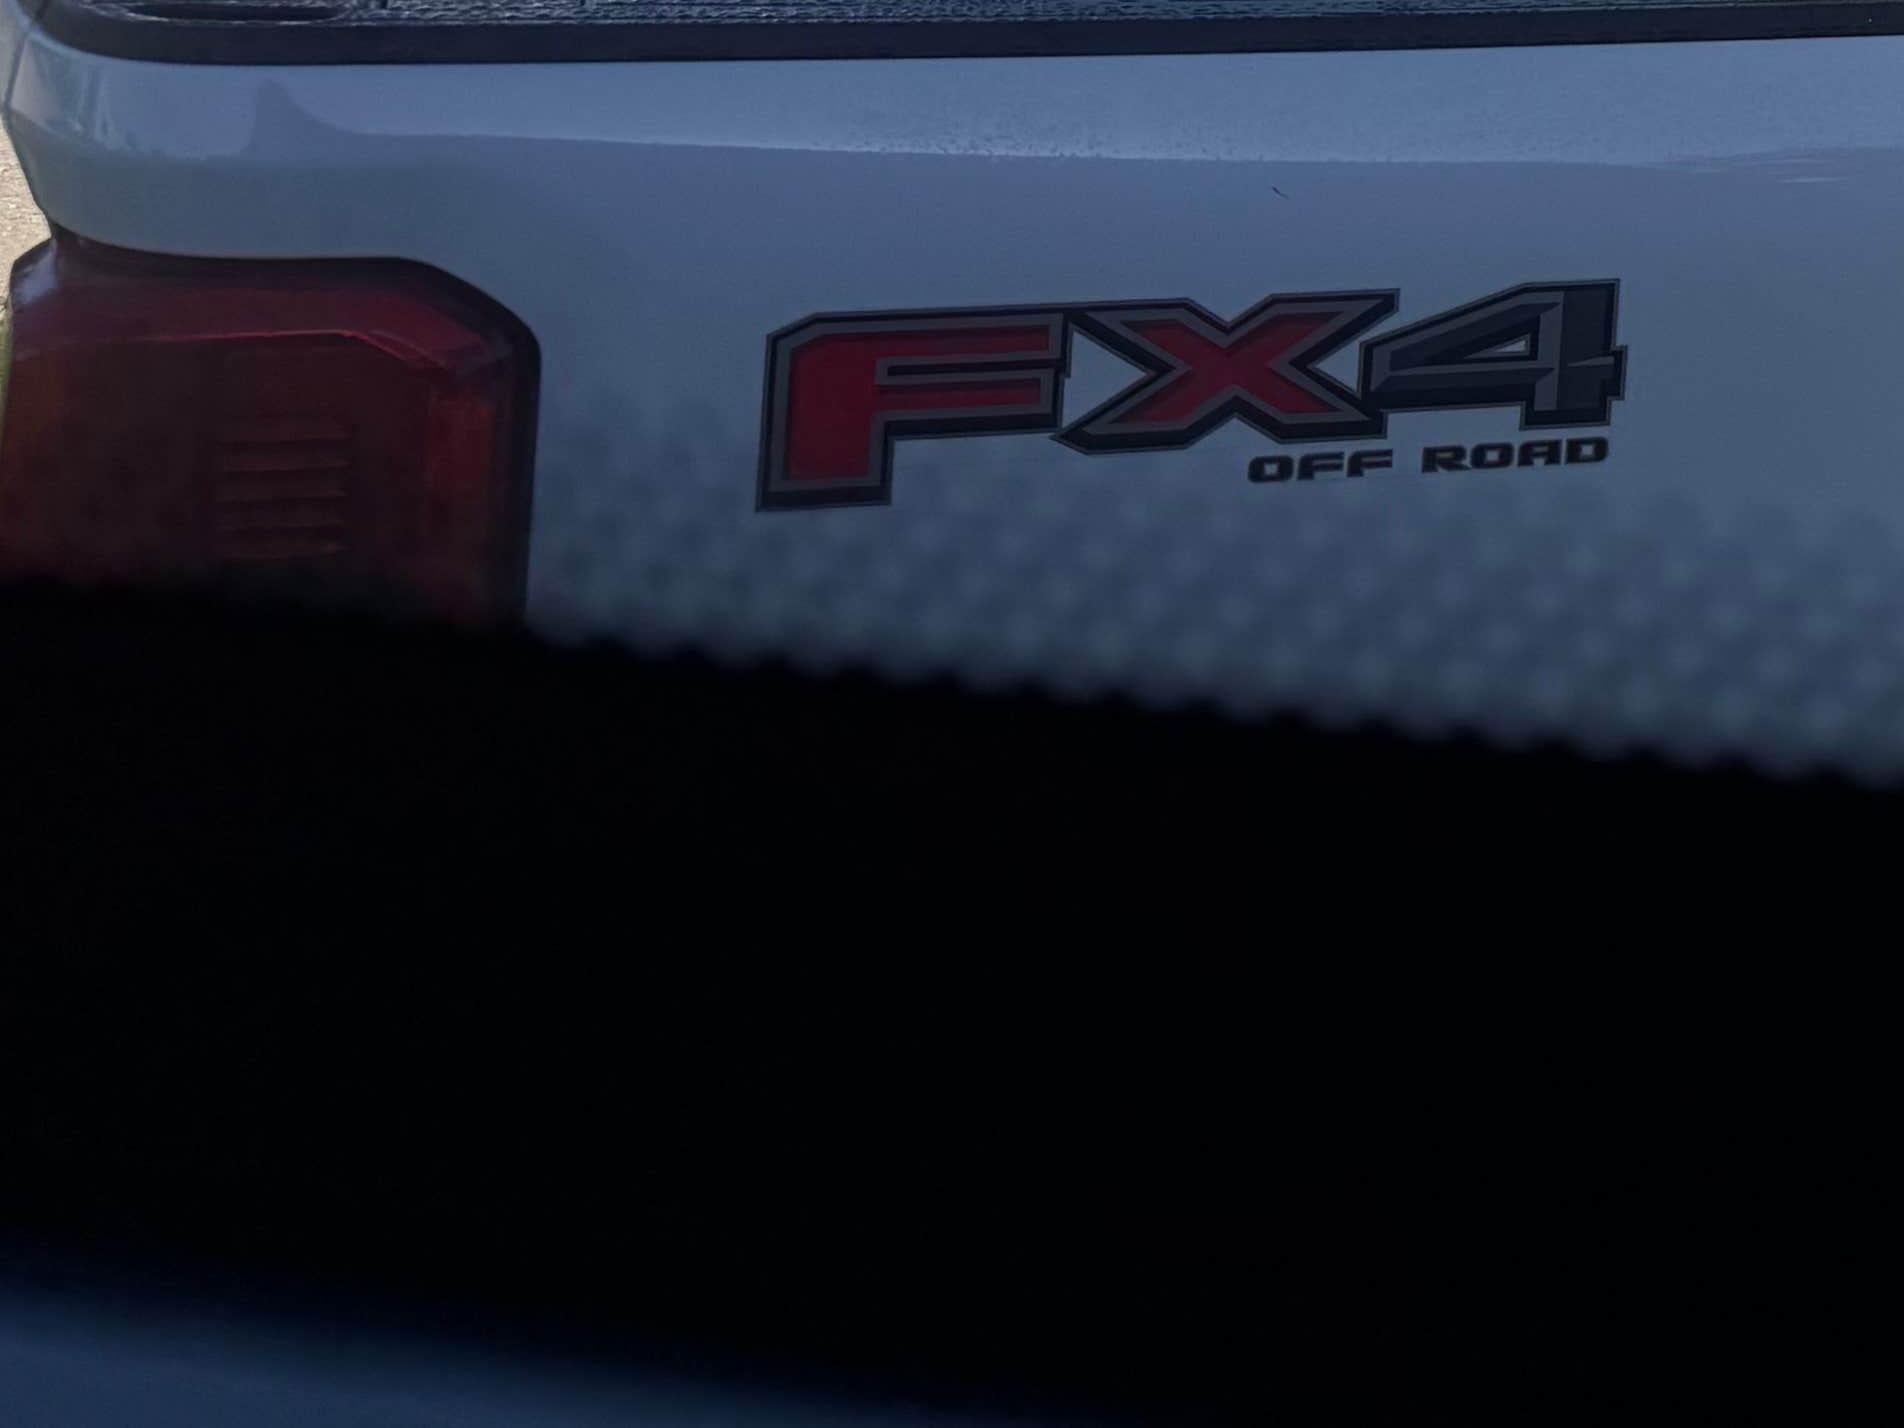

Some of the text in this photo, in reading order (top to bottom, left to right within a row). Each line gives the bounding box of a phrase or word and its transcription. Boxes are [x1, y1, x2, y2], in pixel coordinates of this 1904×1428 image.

[755, 278, 1628, 512] FX4
[1247, 436, 1611, 483] OFF ROAD
